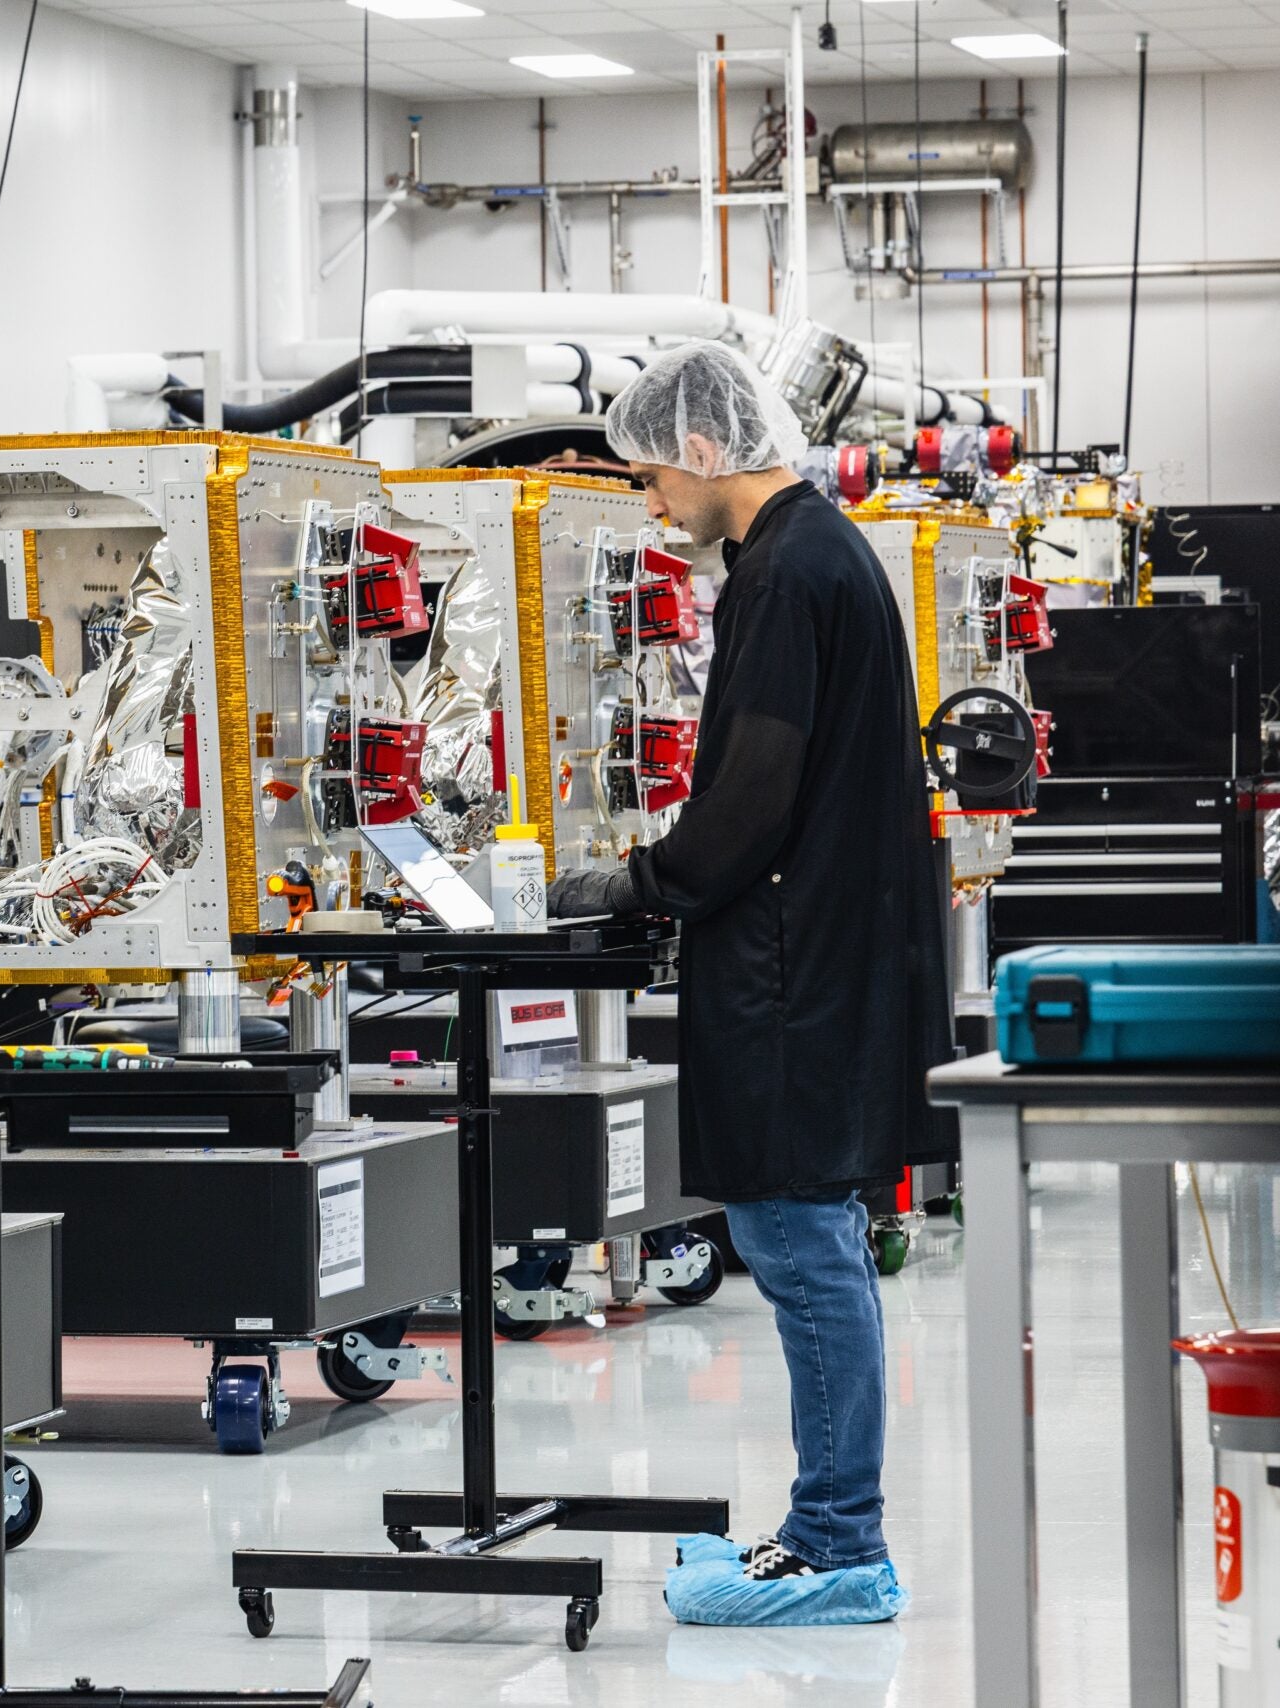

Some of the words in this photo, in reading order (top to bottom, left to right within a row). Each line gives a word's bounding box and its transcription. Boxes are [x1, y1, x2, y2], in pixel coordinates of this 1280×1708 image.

[528, 883, 535, 893] 3
[519, 894, 525, 904] 1
[537, 892, 543, 903] 0
[511, 1007, 531, 1021] BUS
[545, 1004, 565, 1016] OFF
